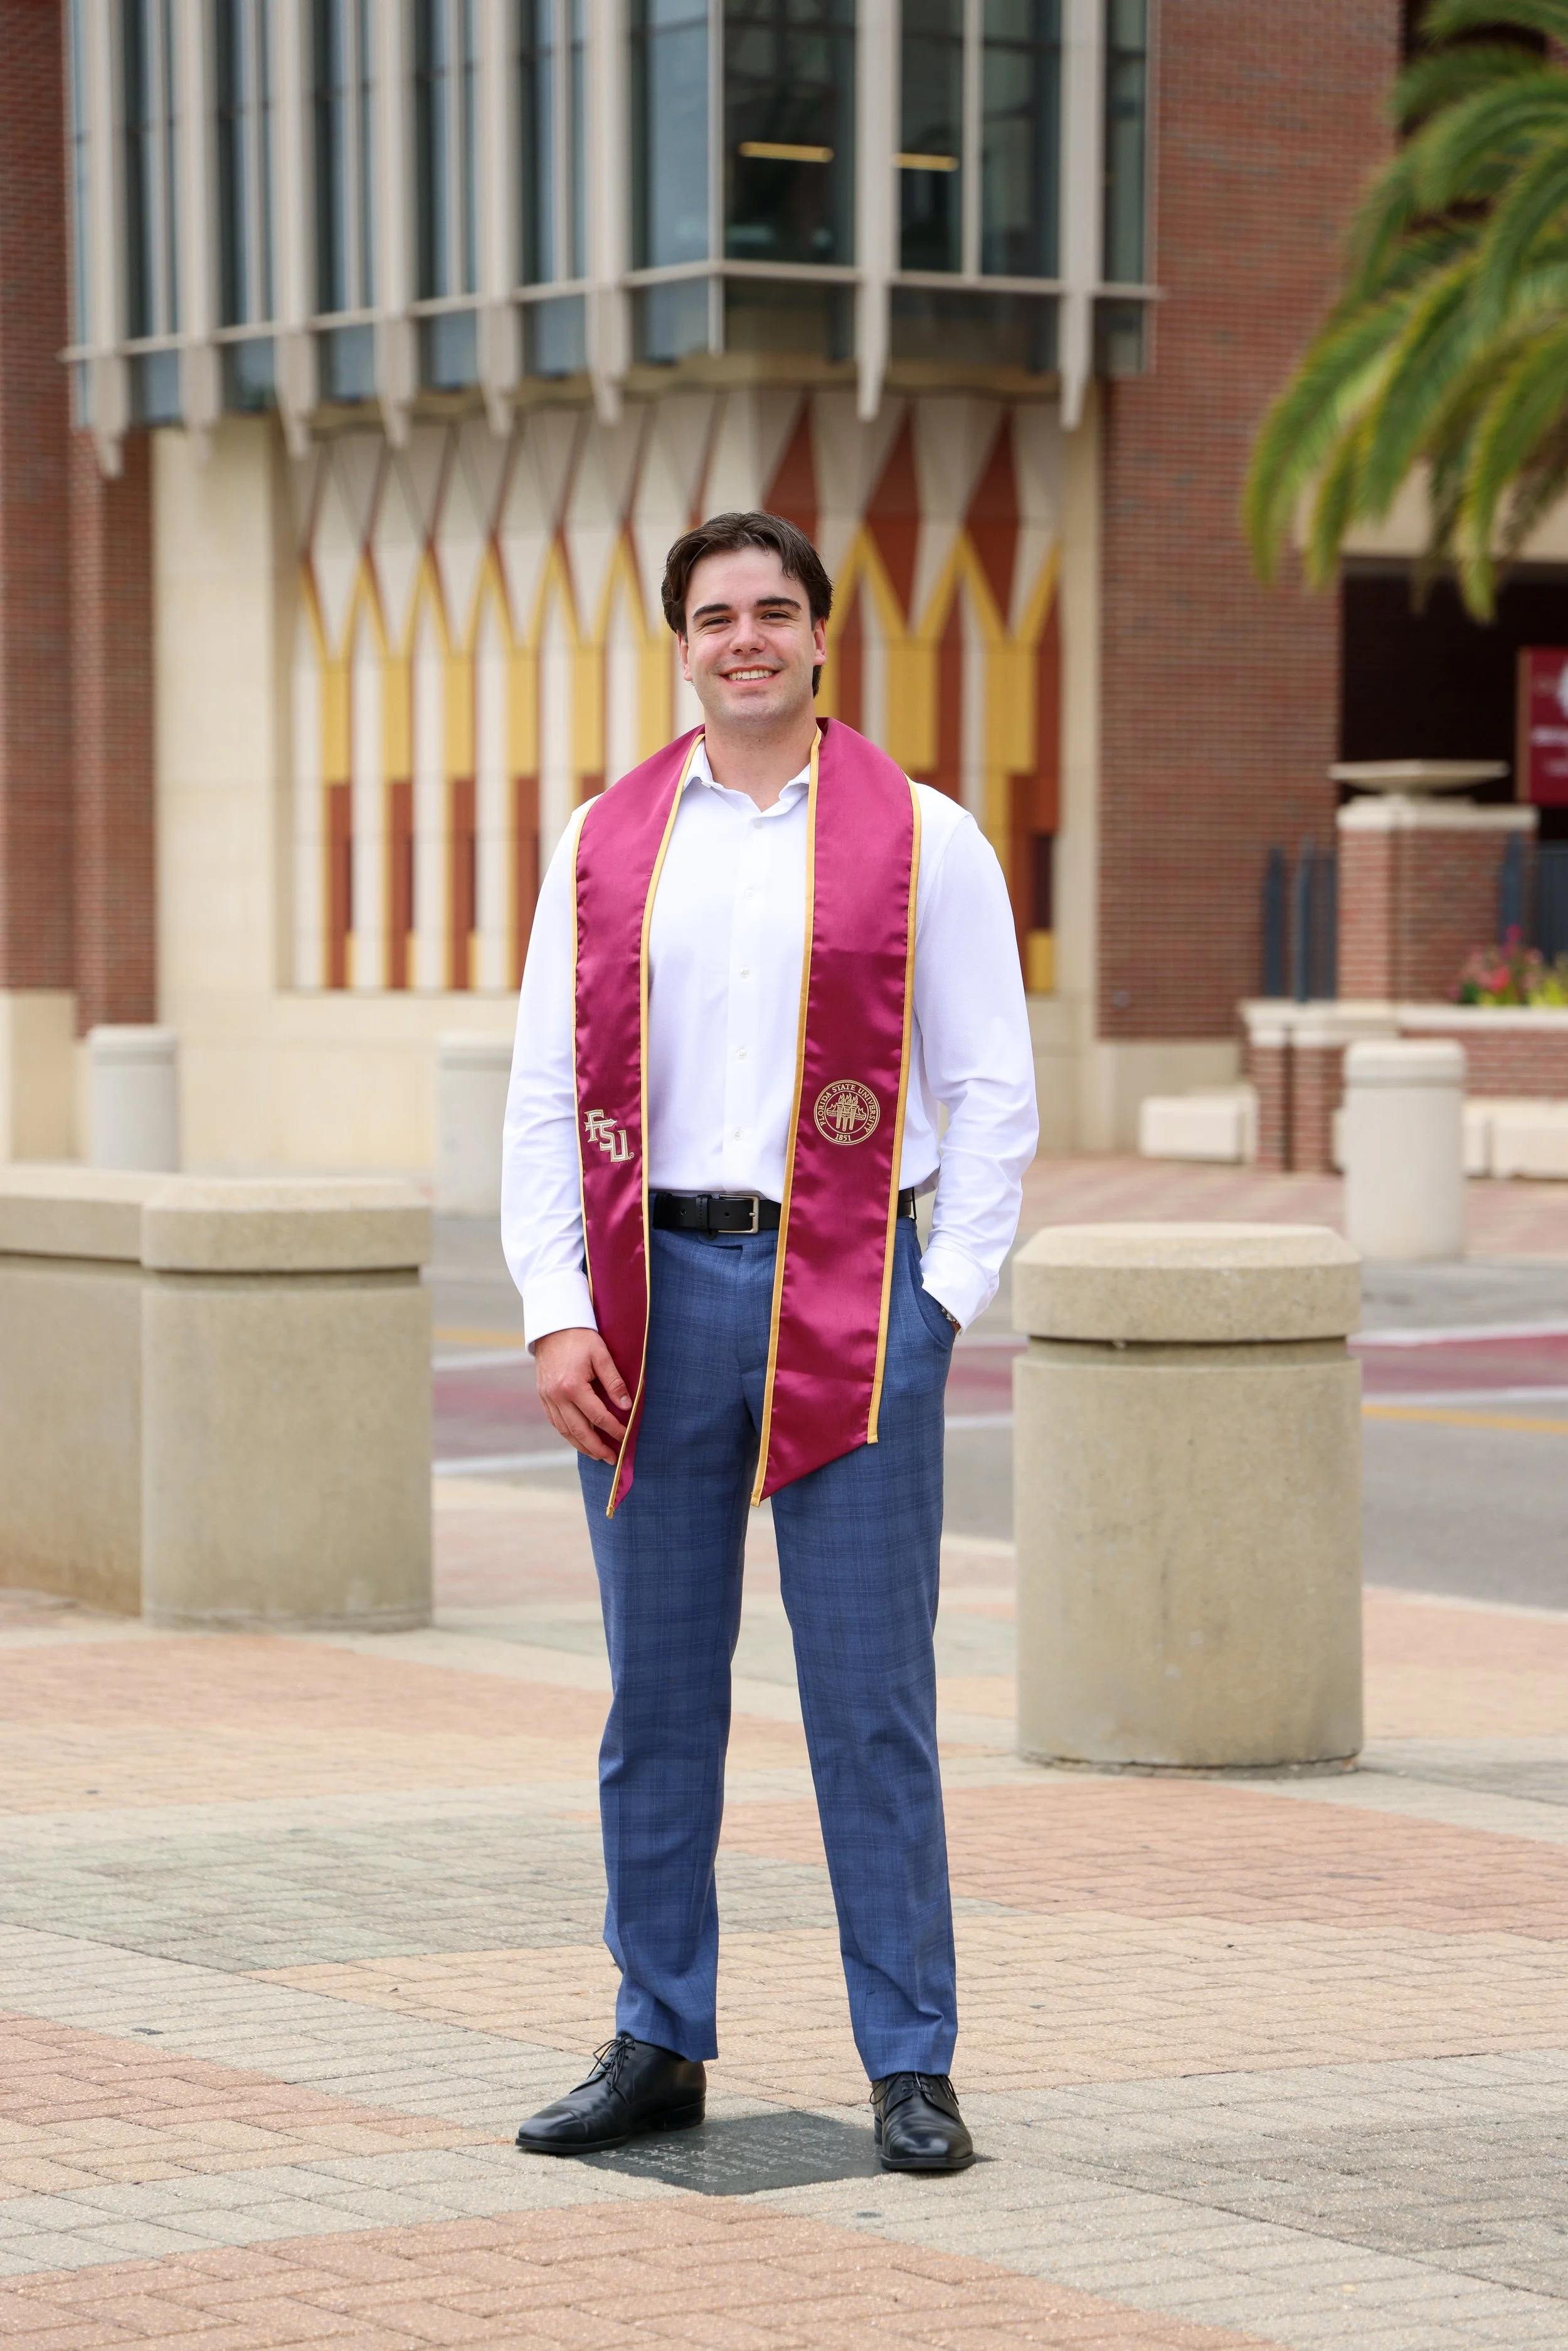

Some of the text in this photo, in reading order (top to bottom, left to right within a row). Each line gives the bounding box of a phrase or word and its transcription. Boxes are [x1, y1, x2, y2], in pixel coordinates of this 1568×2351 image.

[817, 1083, 877, 1133] FLORIDA STATE UNIVERSITY
[584, 1109, 631, 1162] FSU
[835, 1133, 852, 1142] 1851
